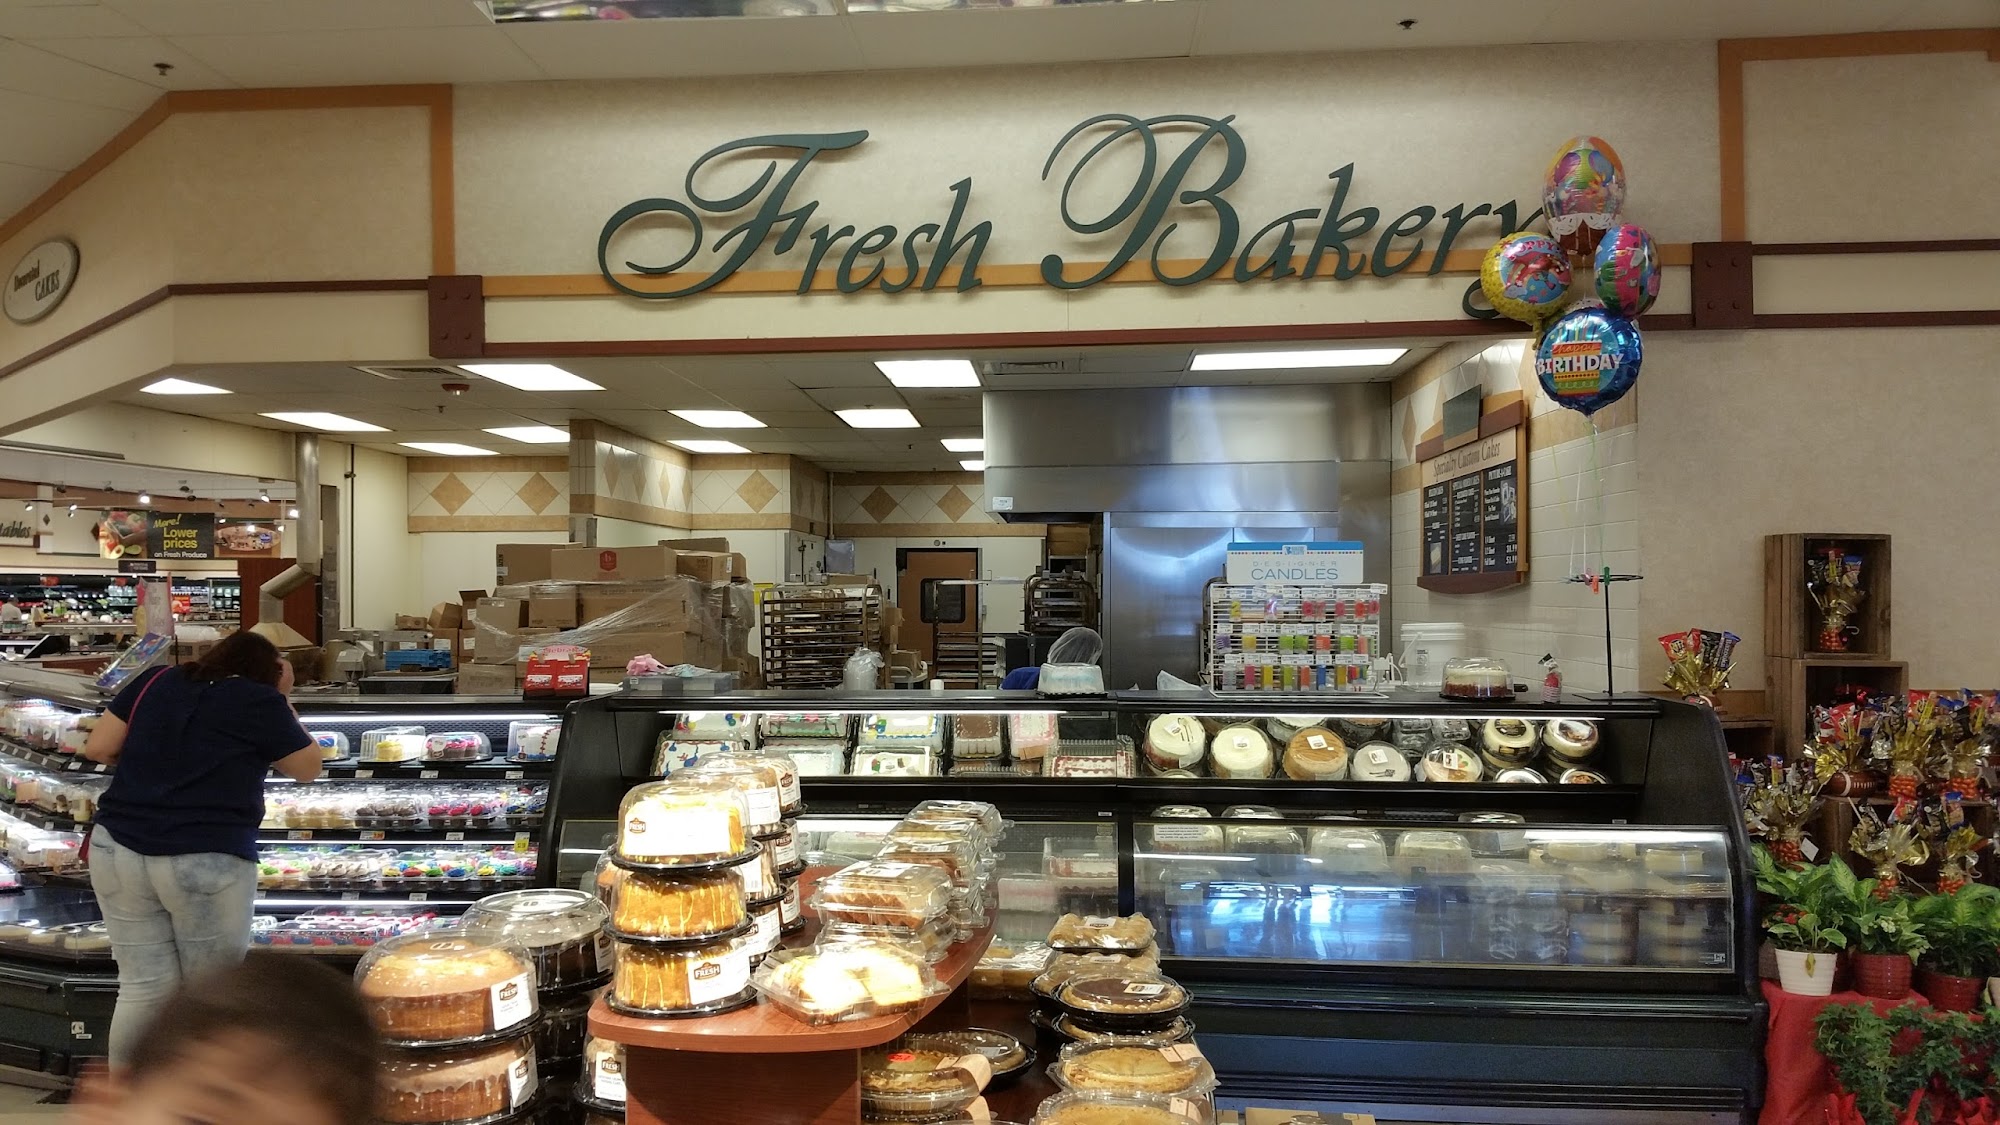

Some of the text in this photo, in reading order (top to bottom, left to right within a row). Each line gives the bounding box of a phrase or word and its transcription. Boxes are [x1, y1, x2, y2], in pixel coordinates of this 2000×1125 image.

[598, 130, 993, 299] Fresh
[35, 269, 60, 301] CAKES
[1554, 343, 1597, 354] happy
[1536, 353, 1624, 375] BIRTHDAY
[1457, 449, 1480, 469] Custom
[1481, 438, 1501, 461] Cakes
[152, 513, 182, 528] More!
[163, 527, 198, 538] Lower
[163, 537, 198, 551] prices
[1251, 568, 1339, 581] CANDLES
[695, 965, 720, 979] FRESH
[602, 1061, 621, 1071] FRESH
